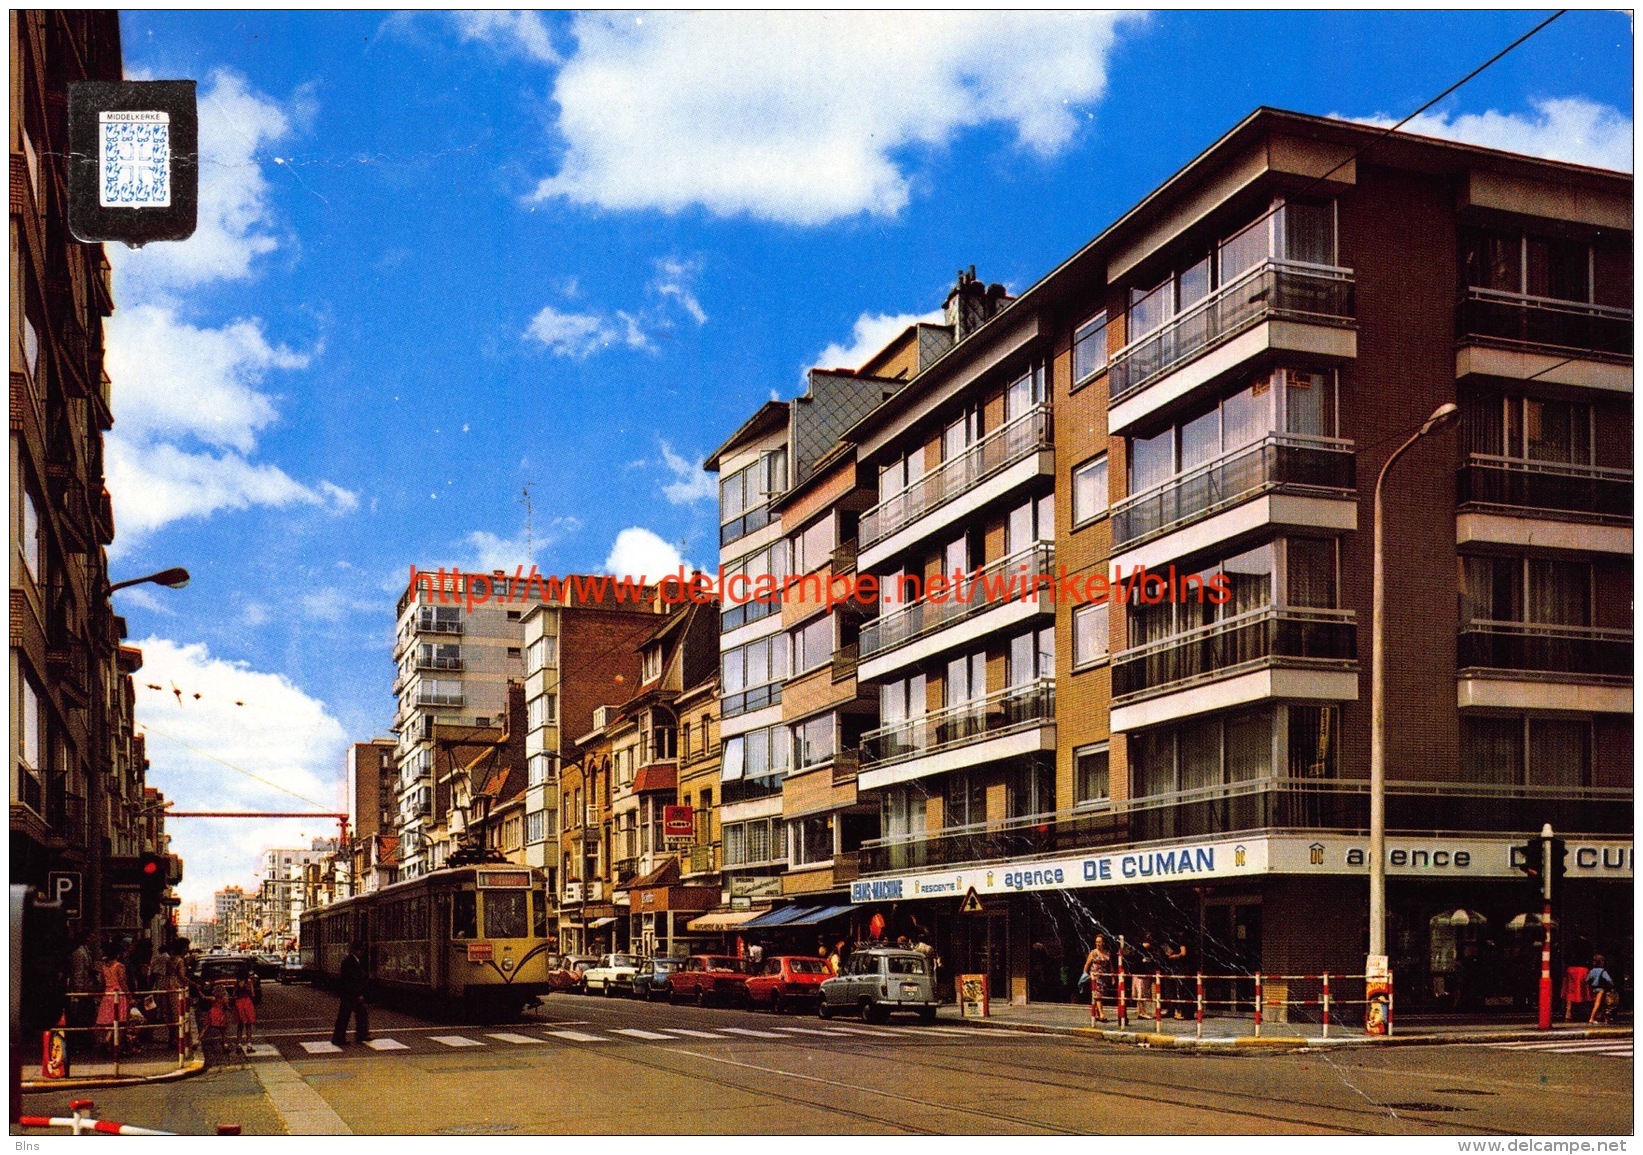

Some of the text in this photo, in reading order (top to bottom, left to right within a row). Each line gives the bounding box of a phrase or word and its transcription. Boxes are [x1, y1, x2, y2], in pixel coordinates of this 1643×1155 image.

[1004, 847, 1215, 890] agence DE CUMAN
[1345, 848, 1471, 869] aence
[1575, 847, 1633, 869] CU
[56, 877, 73, 901] P
[852, 879, 903, 902] JEANS-MACHINE
[921, 882, 956, 894] RESIDENTIE
